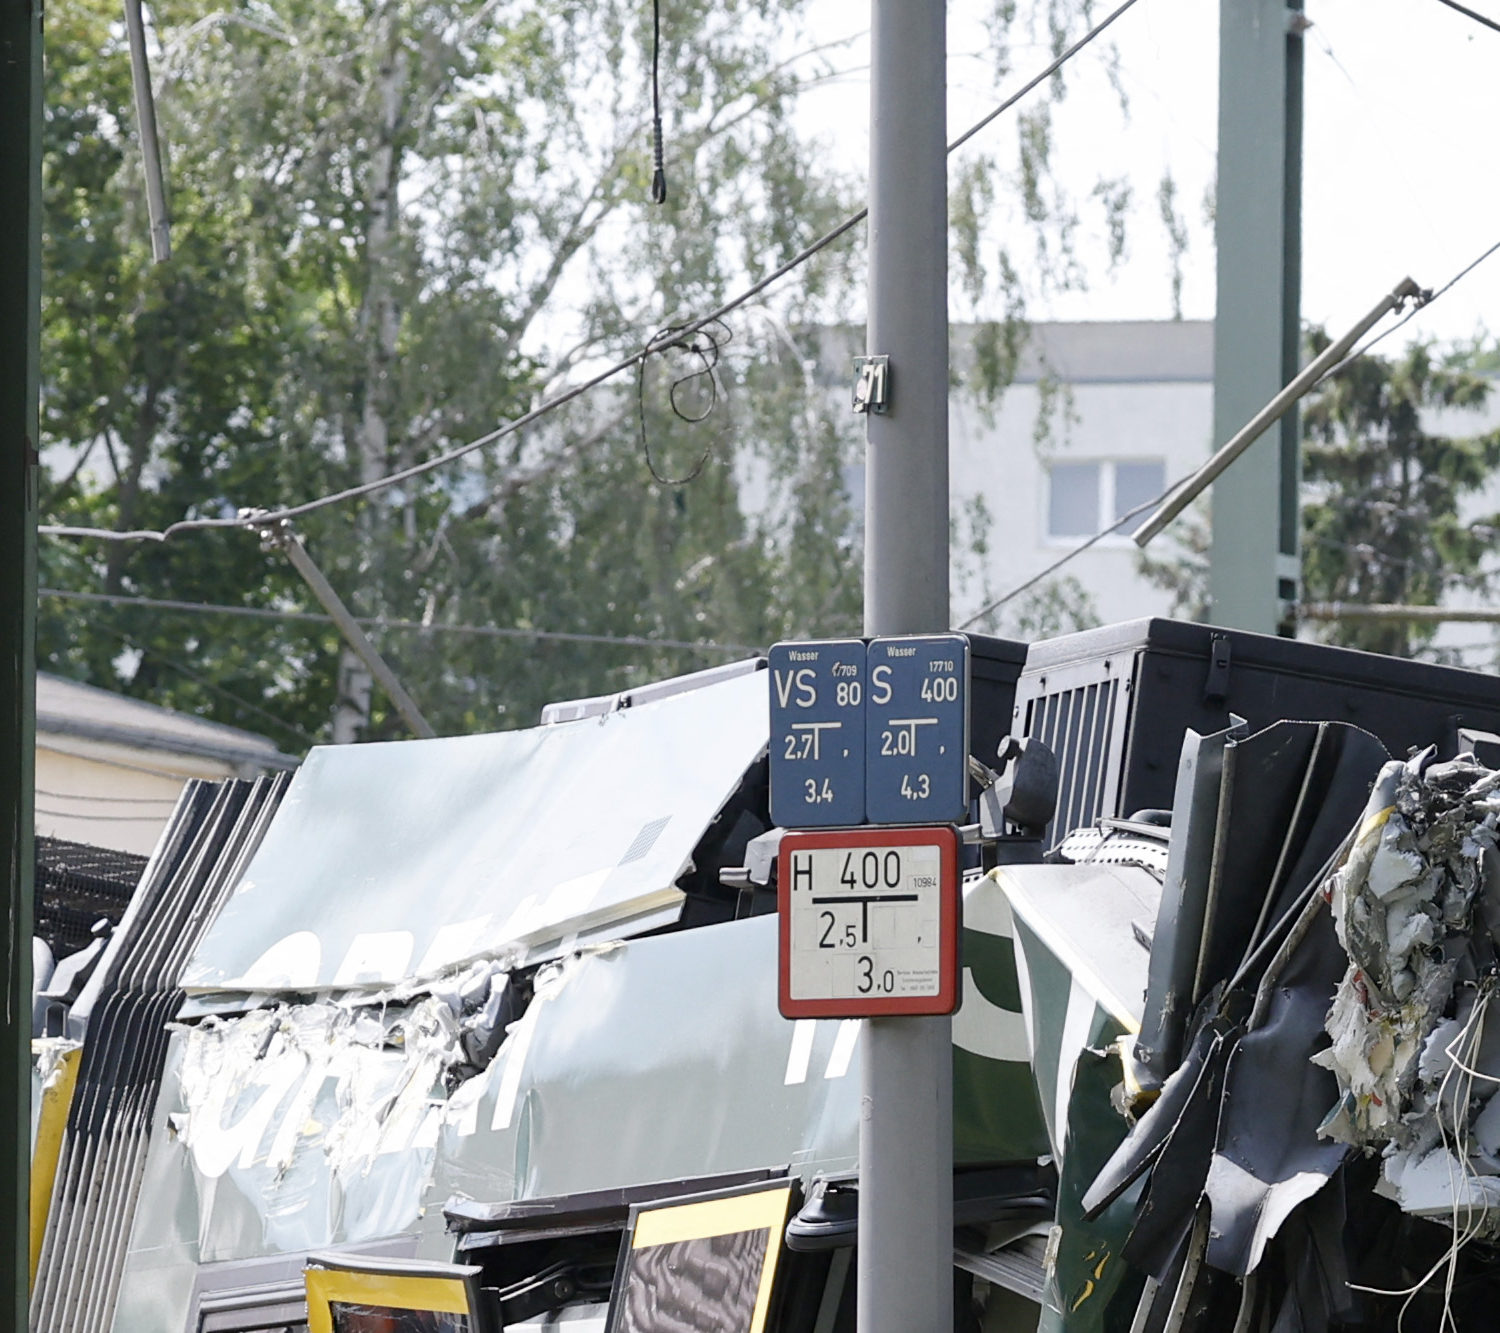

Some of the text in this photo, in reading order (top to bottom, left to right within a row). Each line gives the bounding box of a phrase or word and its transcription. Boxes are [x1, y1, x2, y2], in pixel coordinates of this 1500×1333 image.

[788, 650, 819, 661] Wasser
[887, 646, 916, 657] Wasser
[929, 661, 953, 672] 17710
[774, 669, 861, 708] VS 80
[872, 665, 958, 705] S 400
[784, 734, 812, 760] 2,7
[881, 730, 910, 756] 2,0
[804, 778, 833, 804] 3,4
[900, 774, 930, 800] 4,3
[793, 850, 900, 891] H 400
[819, 910, 857, 949] 2,5
[857, 955, 894, 993] 3,0
